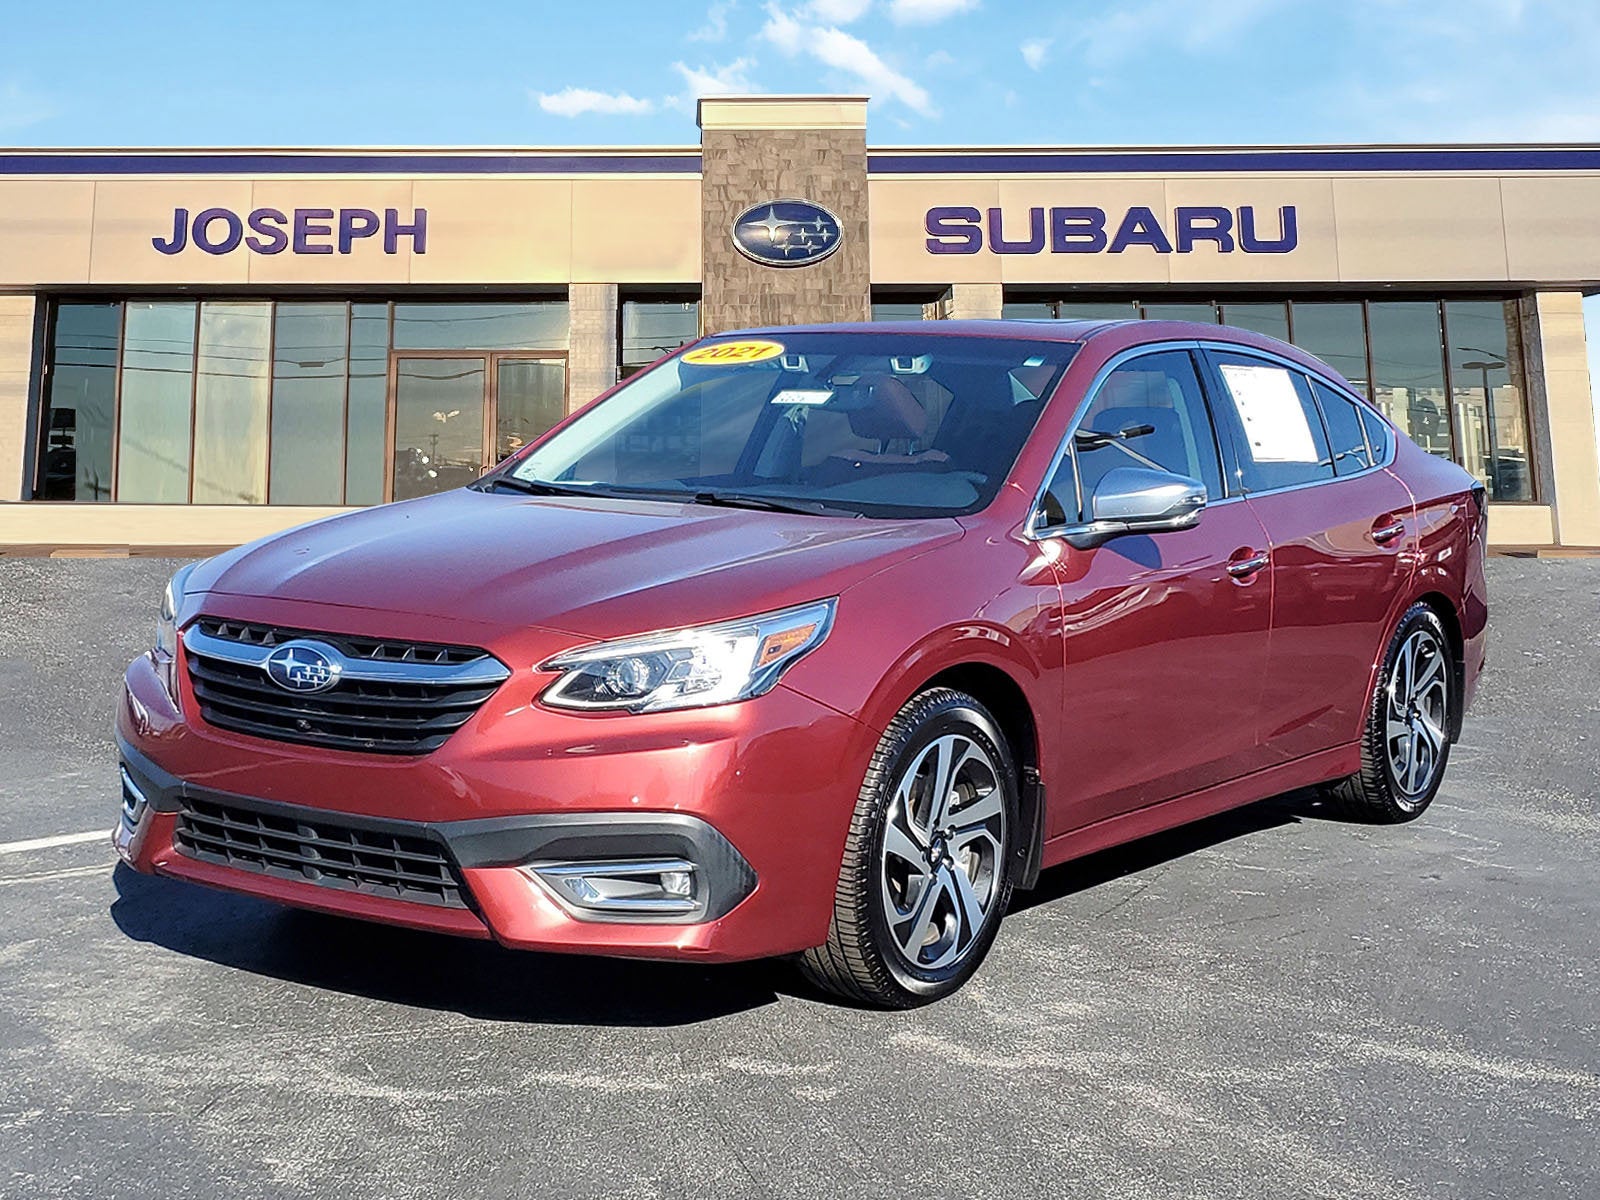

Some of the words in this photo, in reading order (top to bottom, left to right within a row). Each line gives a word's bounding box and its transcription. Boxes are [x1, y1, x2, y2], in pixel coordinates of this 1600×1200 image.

[151, 208, 427, 255] JOSEPH
[925, 205, 1298, 254] SUBARU
[690, 346, 774, 360] 2021
